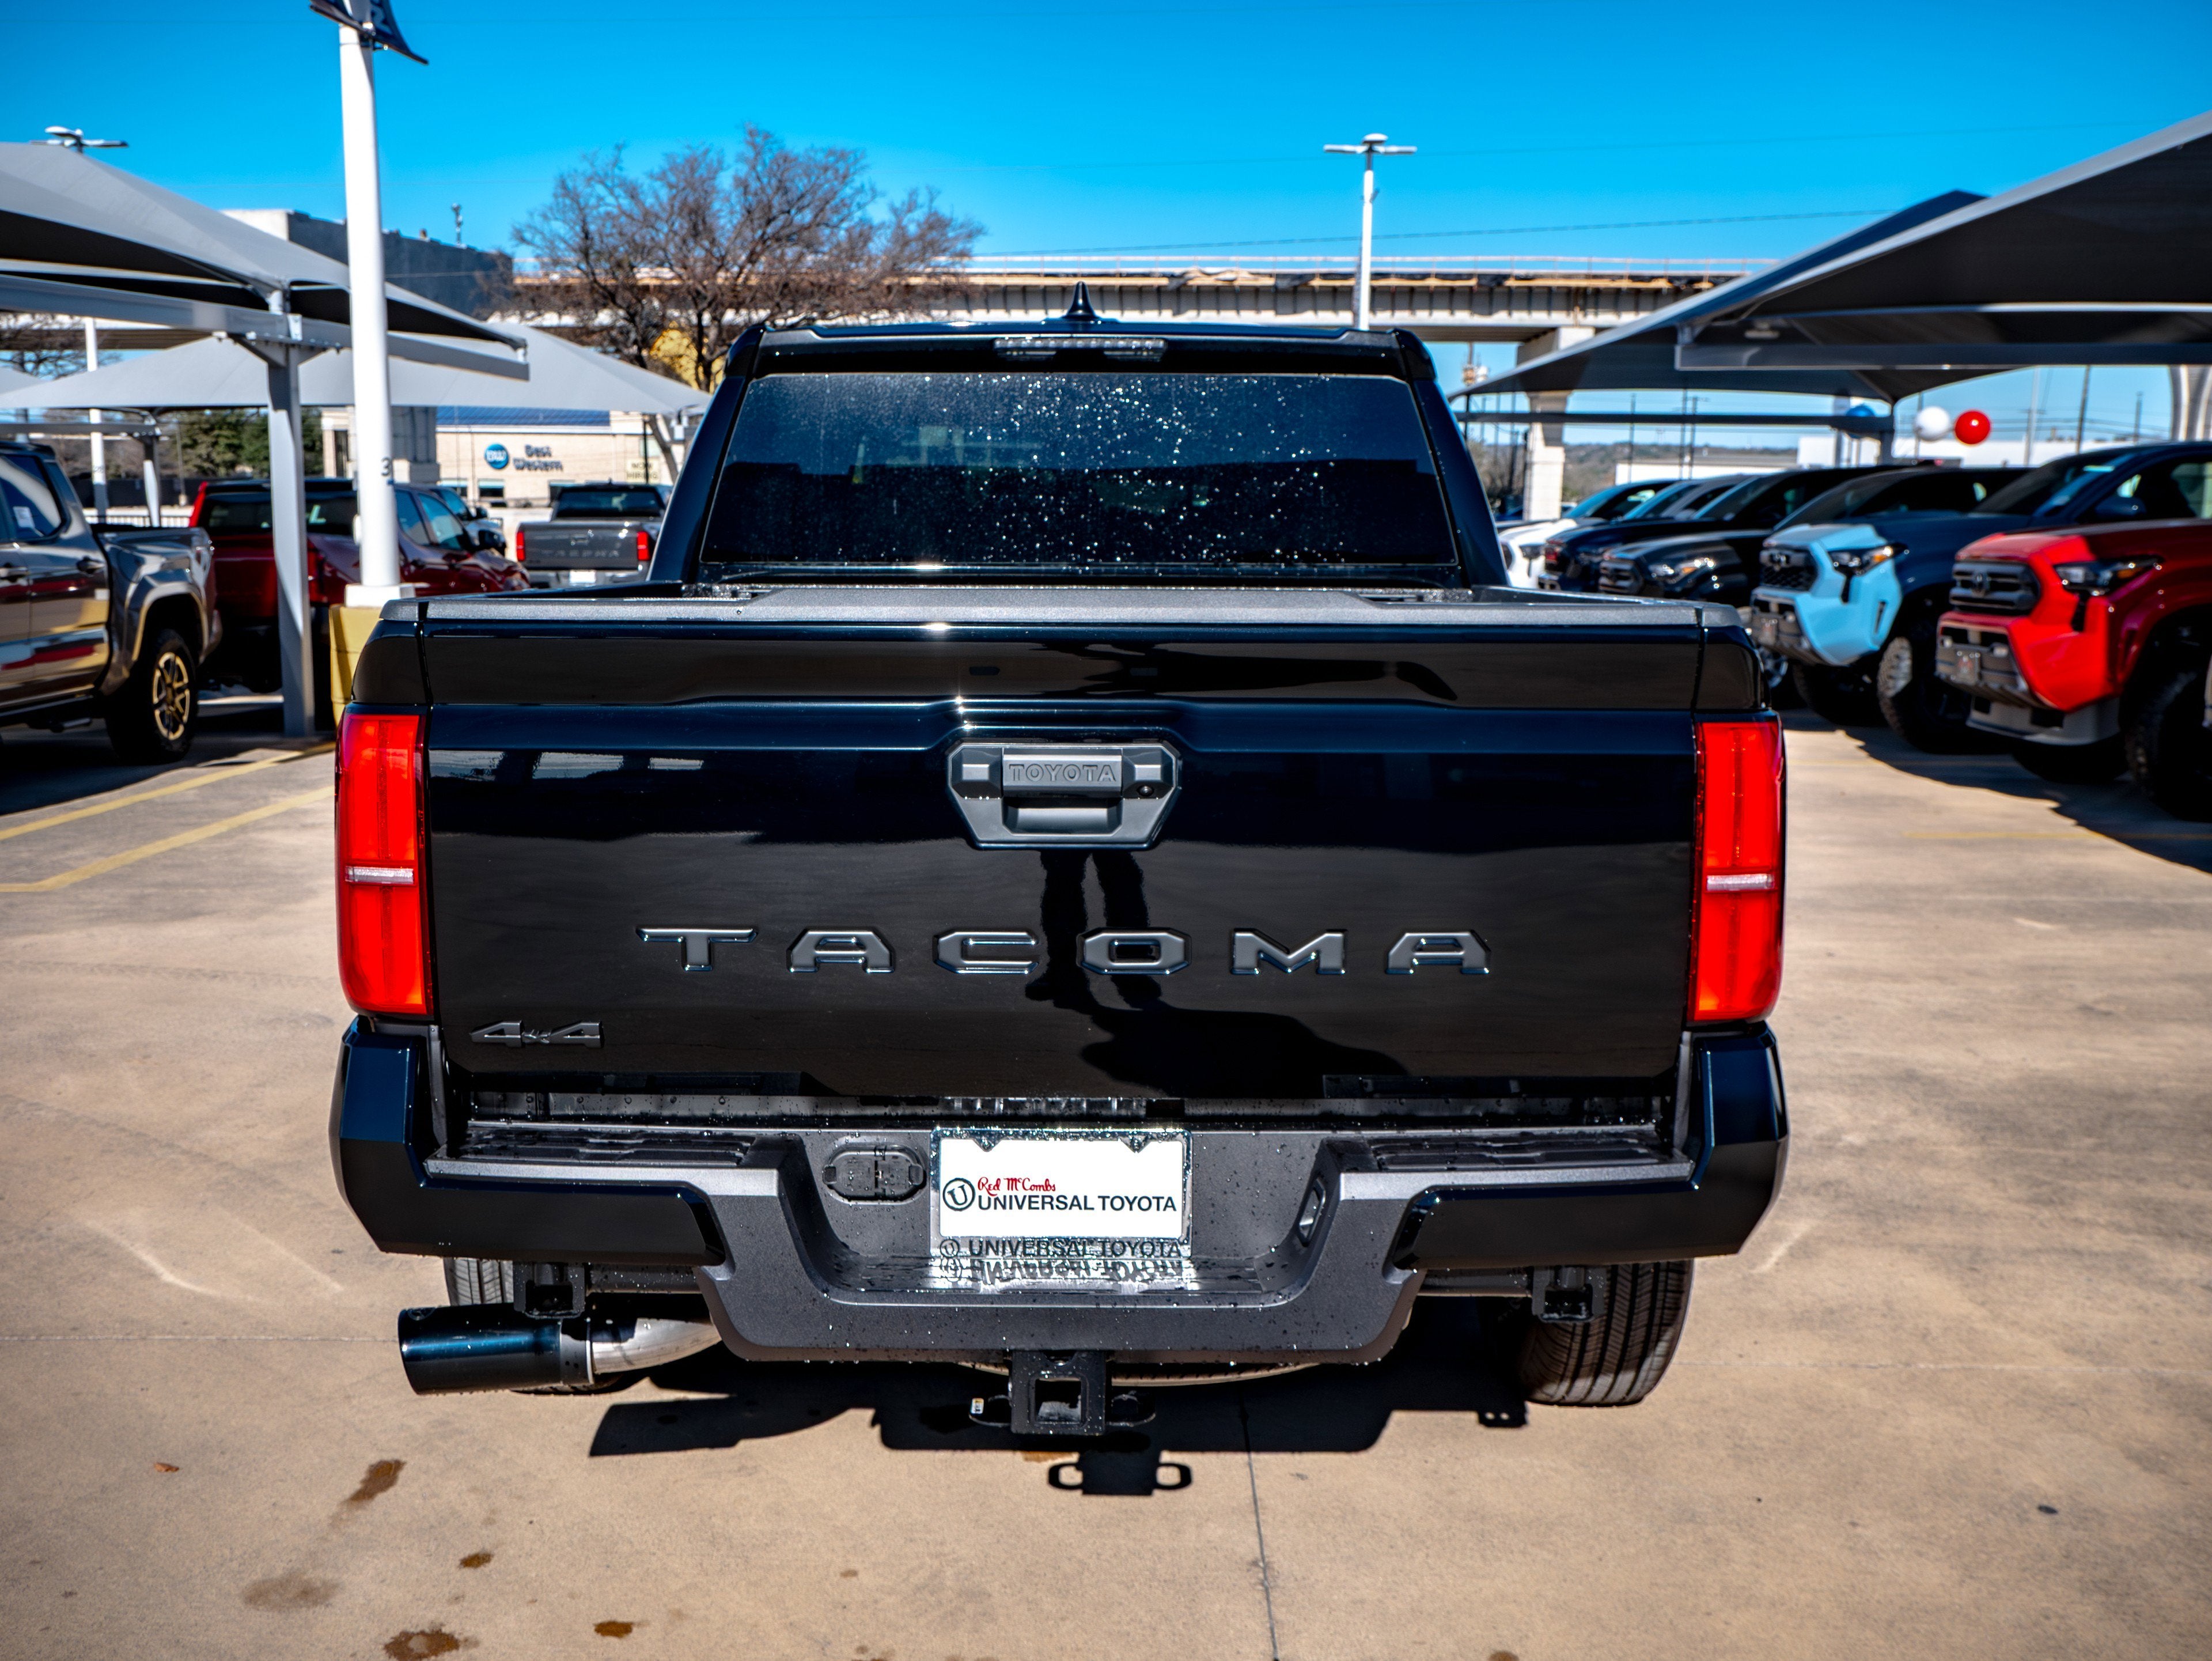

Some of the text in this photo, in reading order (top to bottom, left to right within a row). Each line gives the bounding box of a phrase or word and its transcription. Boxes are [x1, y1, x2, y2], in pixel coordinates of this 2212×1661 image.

[525, 445, 551, 457] Best
[513, 457, 563, 471] Western
[1009, 764, 1117, 782] TOYOTA
[637, 926, 1490, 975] TACOMA
[978, 1176, 1056, 1197] Red McCombs
[978, 1194, 1177, 1212] UNIVERSAL TOYOTA
[969, 1239, 1181, 1258] UNIVERSAL TOYOTA
